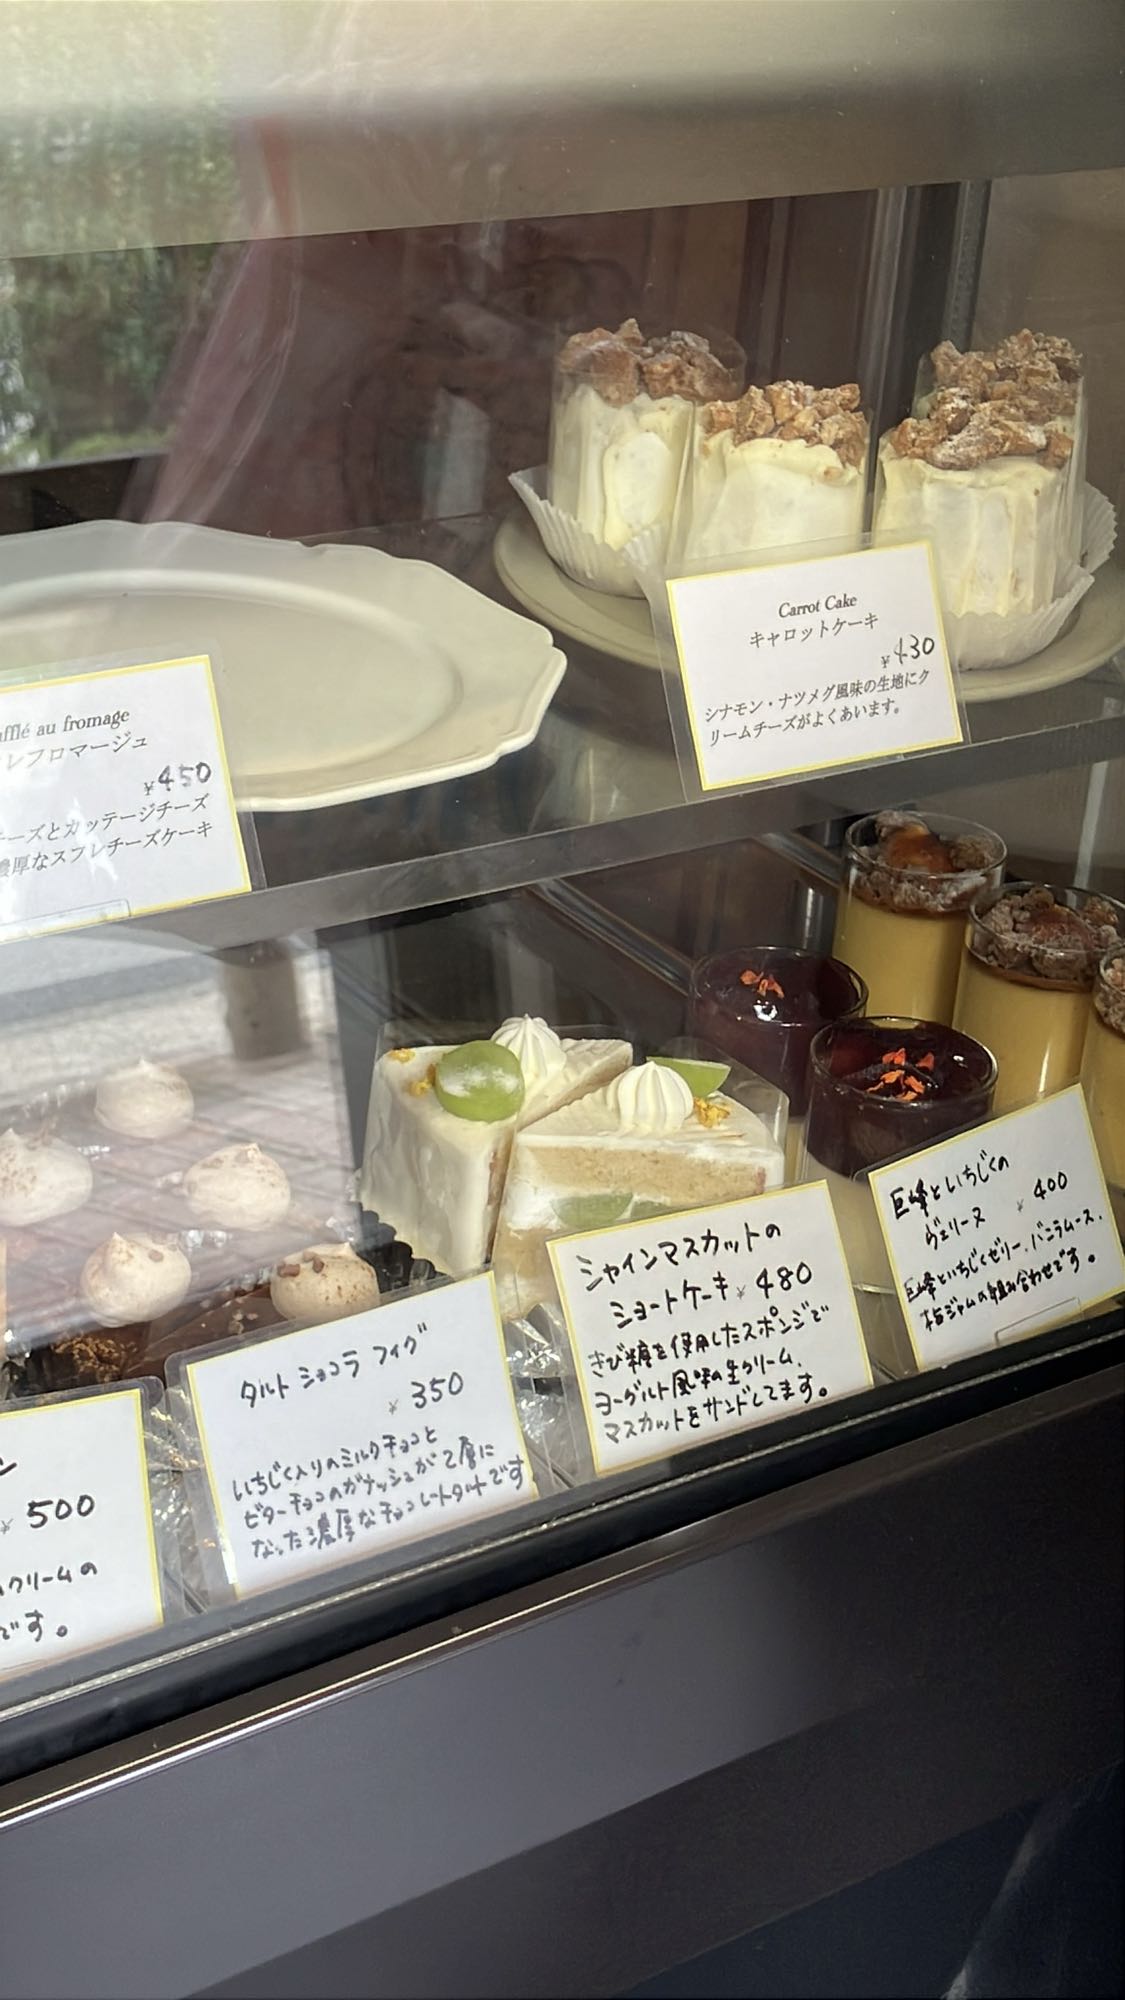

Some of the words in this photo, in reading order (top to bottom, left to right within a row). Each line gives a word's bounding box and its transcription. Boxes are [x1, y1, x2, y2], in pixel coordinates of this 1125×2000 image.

[749, 612, 879, 649] キャロットケーキ
[778, 599, 821, 619] Carrot
[825, 593, 858, 611] Cake
[704, 669, 930, 723] シナモン・ナツメグ風味の生地にク
[0, 723, 31, 742] fflé
[36, 723, 56, 738] au
[63, 710, 130, 733] fromage
[709, 698, 901, 747] リームチーズがよくあいます。
[890, 1150, 1009, 1220] 巨峰といちじくの
[576, 1222, 781, 1291] シャインマスカットの
[588, 1301, 829, 1377] きび糖を使用したスポンジで
[604, 1372, 828, 1444] マスカットをサンドしてます。
[0, 1561, 97, 1597] クリームの
